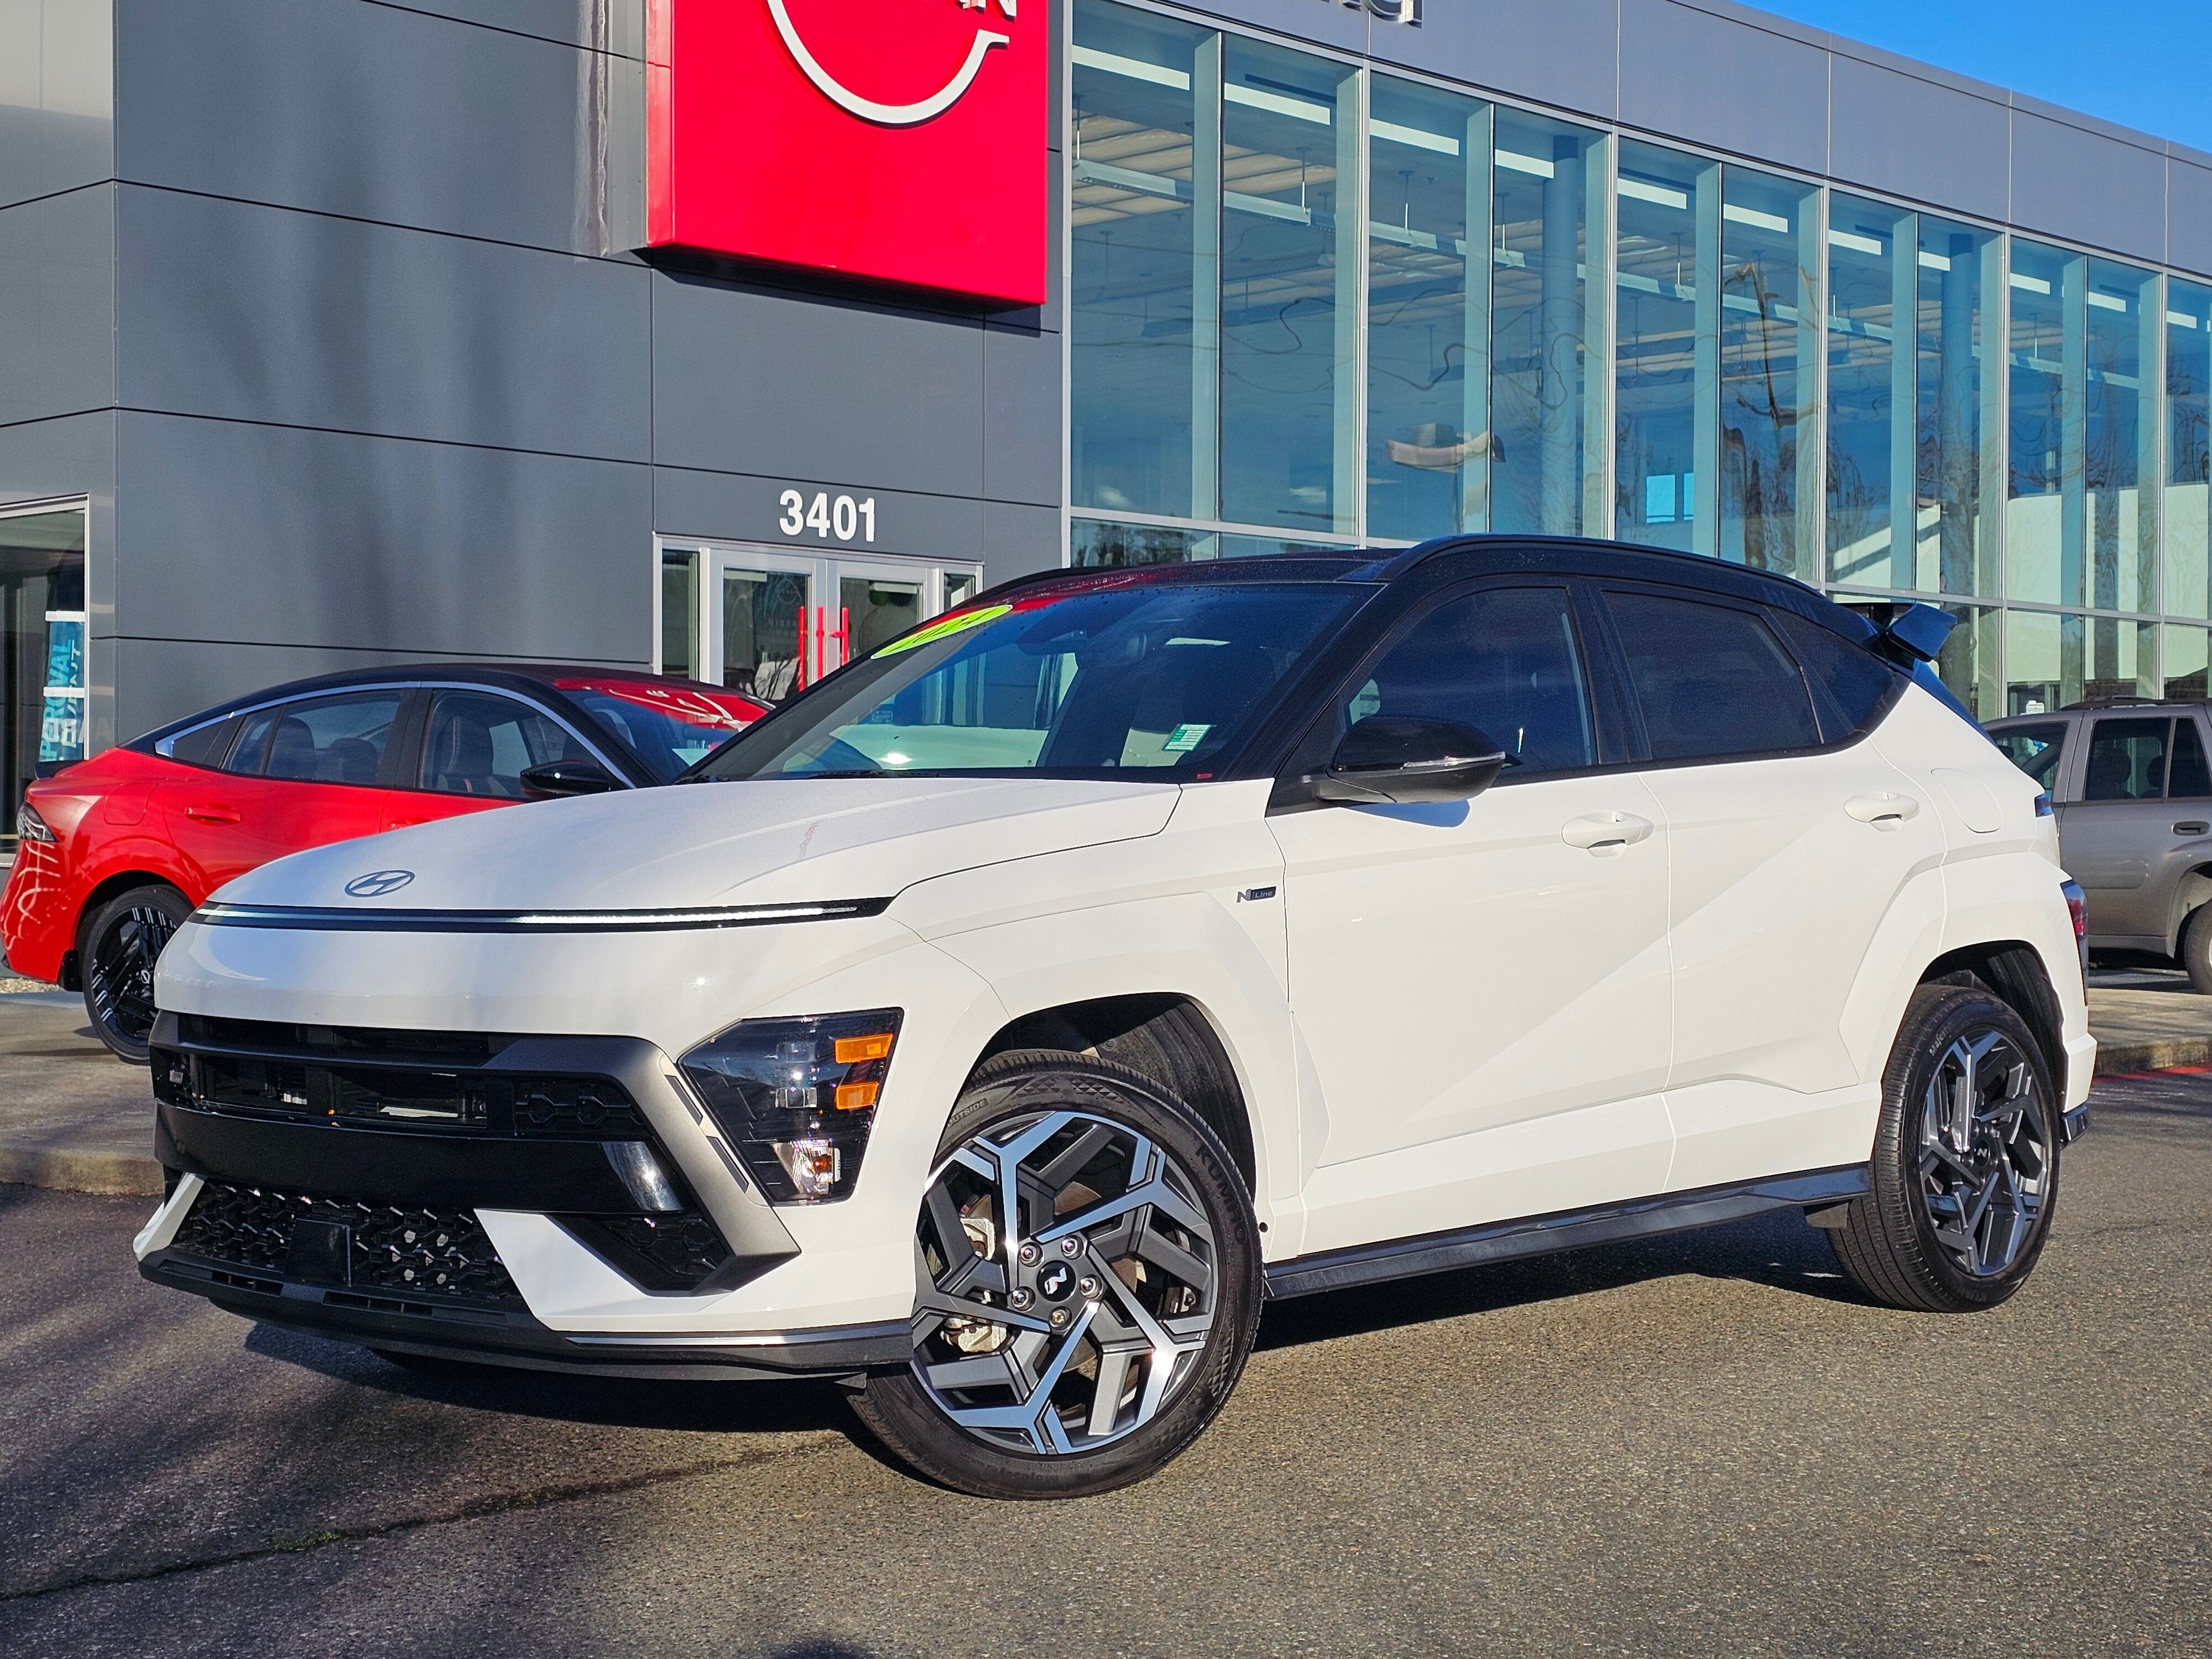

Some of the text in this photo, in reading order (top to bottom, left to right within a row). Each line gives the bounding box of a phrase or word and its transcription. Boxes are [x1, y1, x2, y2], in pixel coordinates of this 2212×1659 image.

[779, 490, 875, 542] 3401
[1237, 889, 1251, 903] N
[947, 1099, 986, 1128] OUTSIDE
[1194, 1144, 1248, 1244] KUMHO
